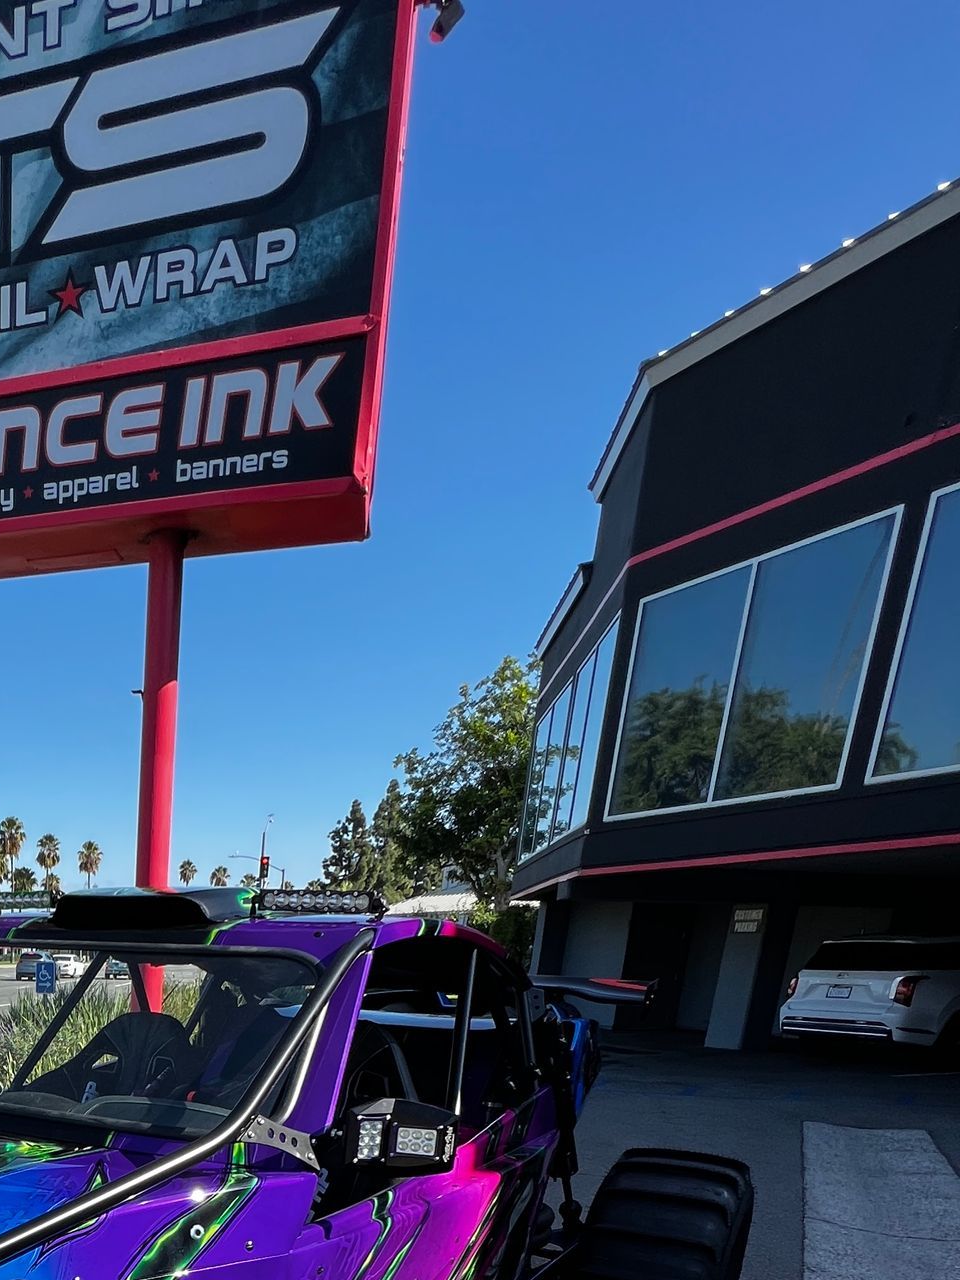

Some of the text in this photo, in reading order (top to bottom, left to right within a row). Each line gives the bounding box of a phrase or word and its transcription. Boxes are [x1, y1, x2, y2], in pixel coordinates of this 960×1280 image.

[93, 226, 298, 315] WRAP
[177, 352, 346, 450] INK
[42, 466, 140, 505] apparel
[174, 449, 290, 484] banners
